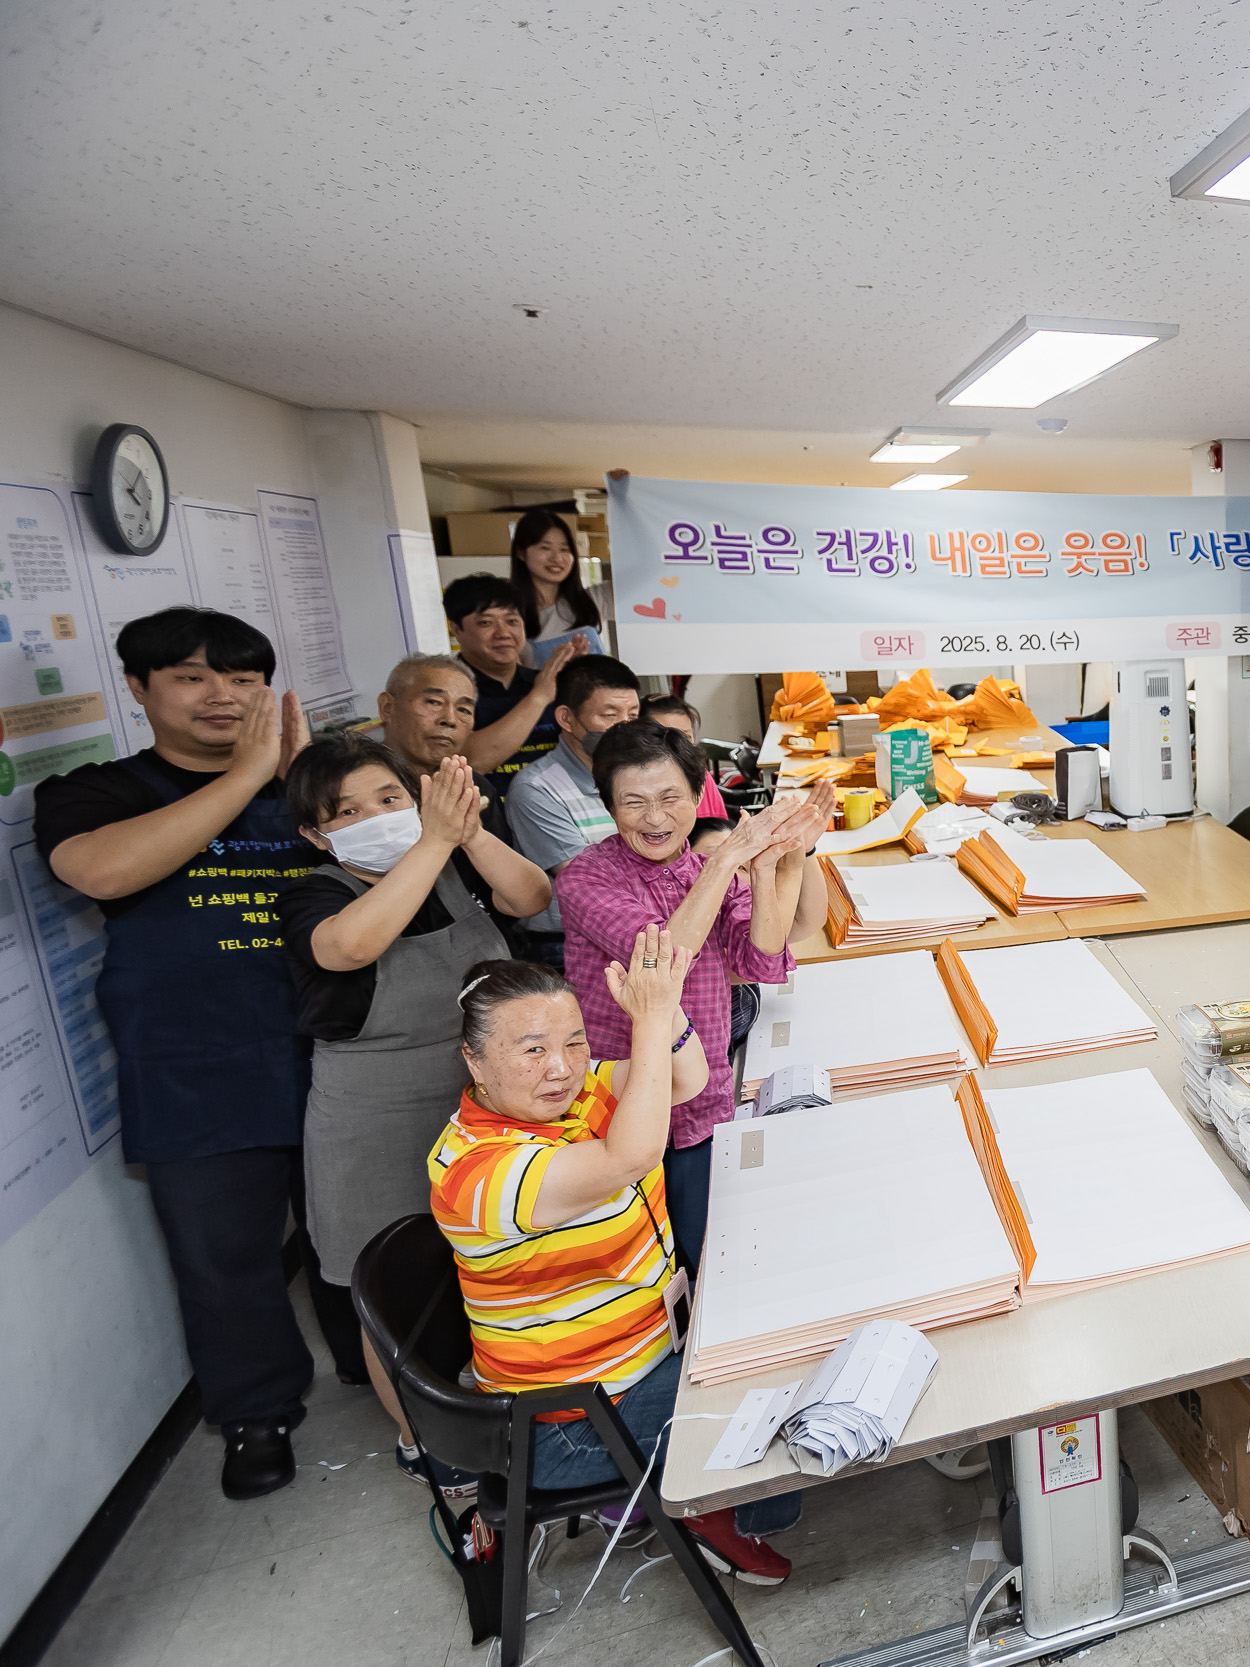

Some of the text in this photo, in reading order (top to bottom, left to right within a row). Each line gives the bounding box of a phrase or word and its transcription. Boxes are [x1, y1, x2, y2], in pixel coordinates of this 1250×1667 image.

[662, 521, 801, 573] 오늘은
[814, 528, 914, 576] 건강!
[928, 530, 1048, 576] 내일은
[1060, 530, 1148, 576] 웃음!
[1176, 626, 1212, 647] 주관
[873, 635, 915, 656] 일자
[940, 635, 990, 653] 2025.
[996, 634, 1013, 652] 8.
[188, 867, 228, 878] #쇼핑백
[230, 868, 282, 879] #패키지박스
[207, 892, 250, 906] 쇼핑백
[241, 911, 270, 924] 제일
[218, 939, 249, 951] TEL.
